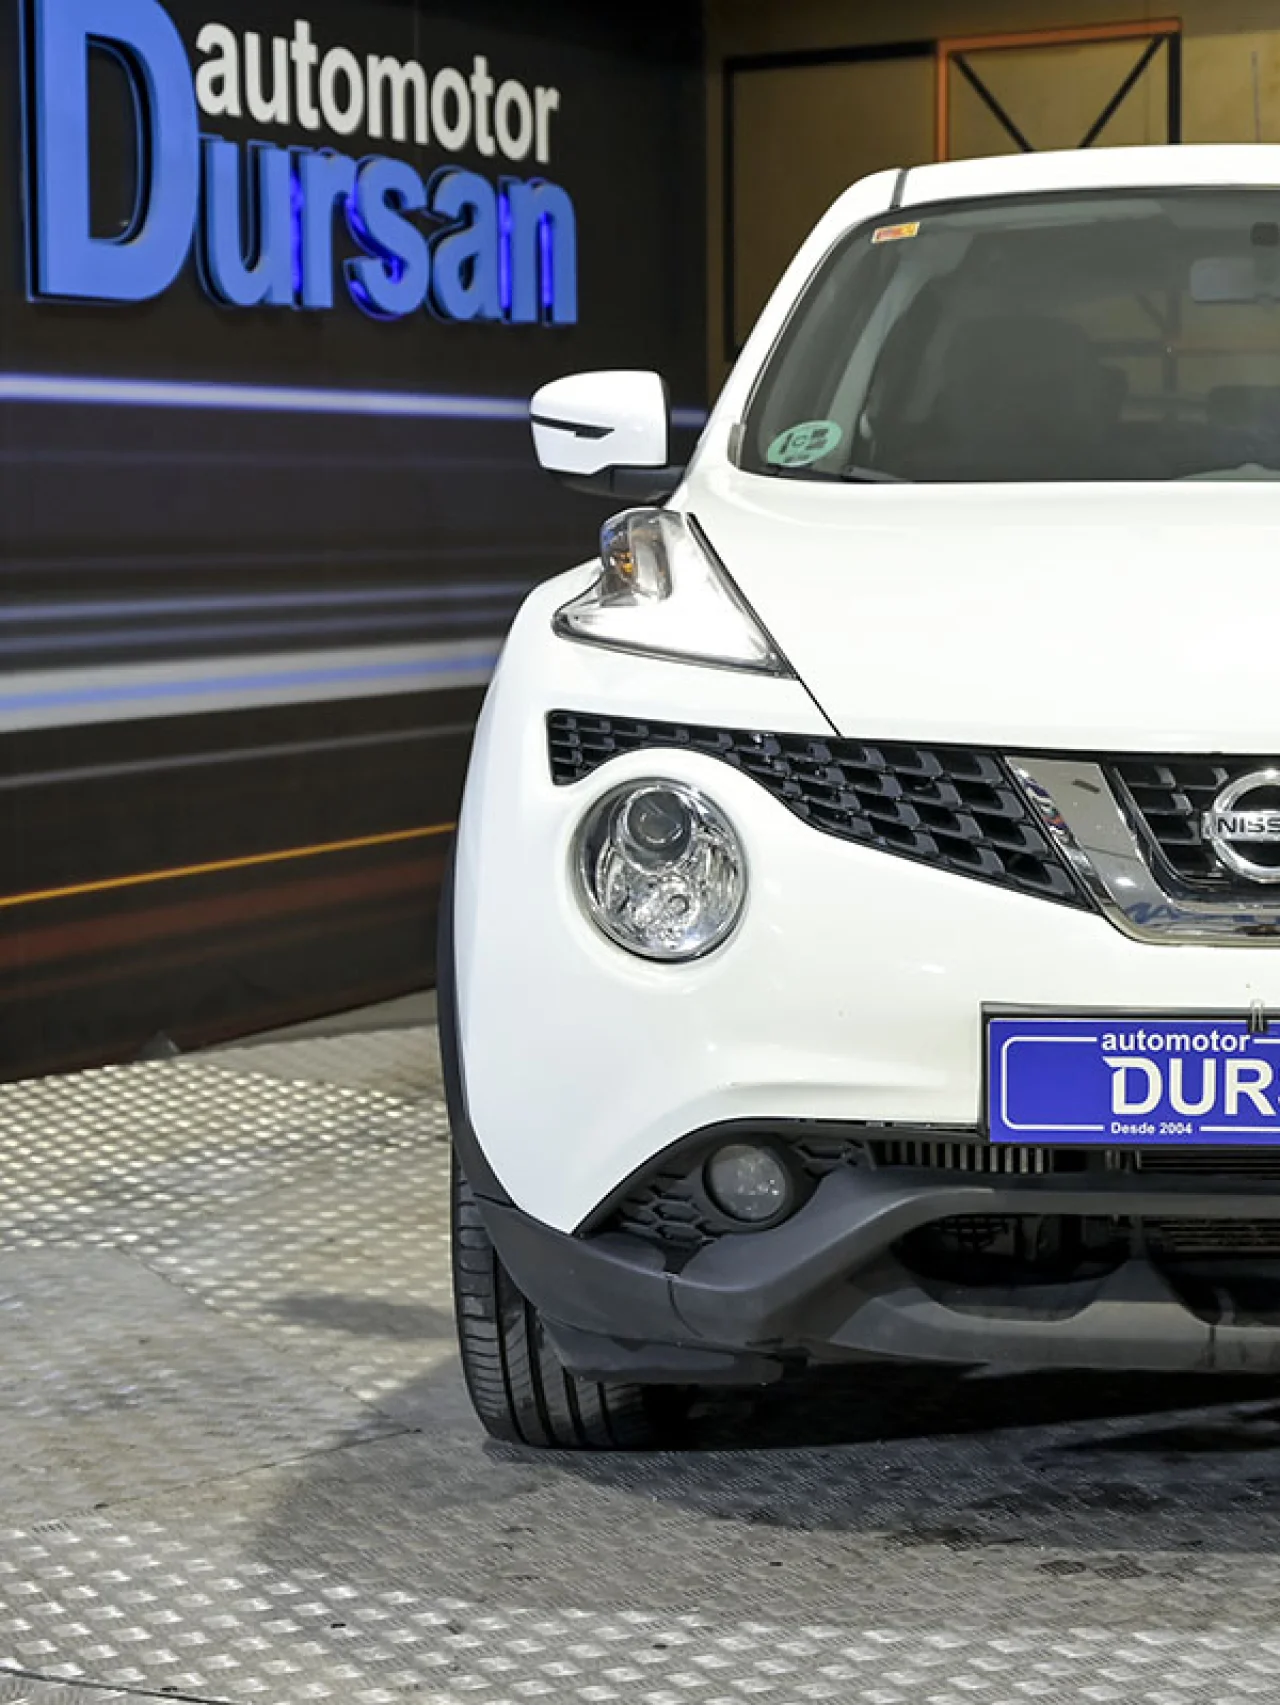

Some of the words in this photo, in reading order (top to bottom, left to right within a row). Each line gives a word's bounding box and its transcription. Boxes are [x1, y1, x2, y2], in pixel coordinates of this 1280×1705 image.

[195, 19, 561, 163] automotor
[22, 0, 578, 325] Dursan
[1101, 1029, 1251, 1052] automotor
[1110, 1121, 1155, 1134] Desde
[1159, 1121, 1192, 1134] 2004
